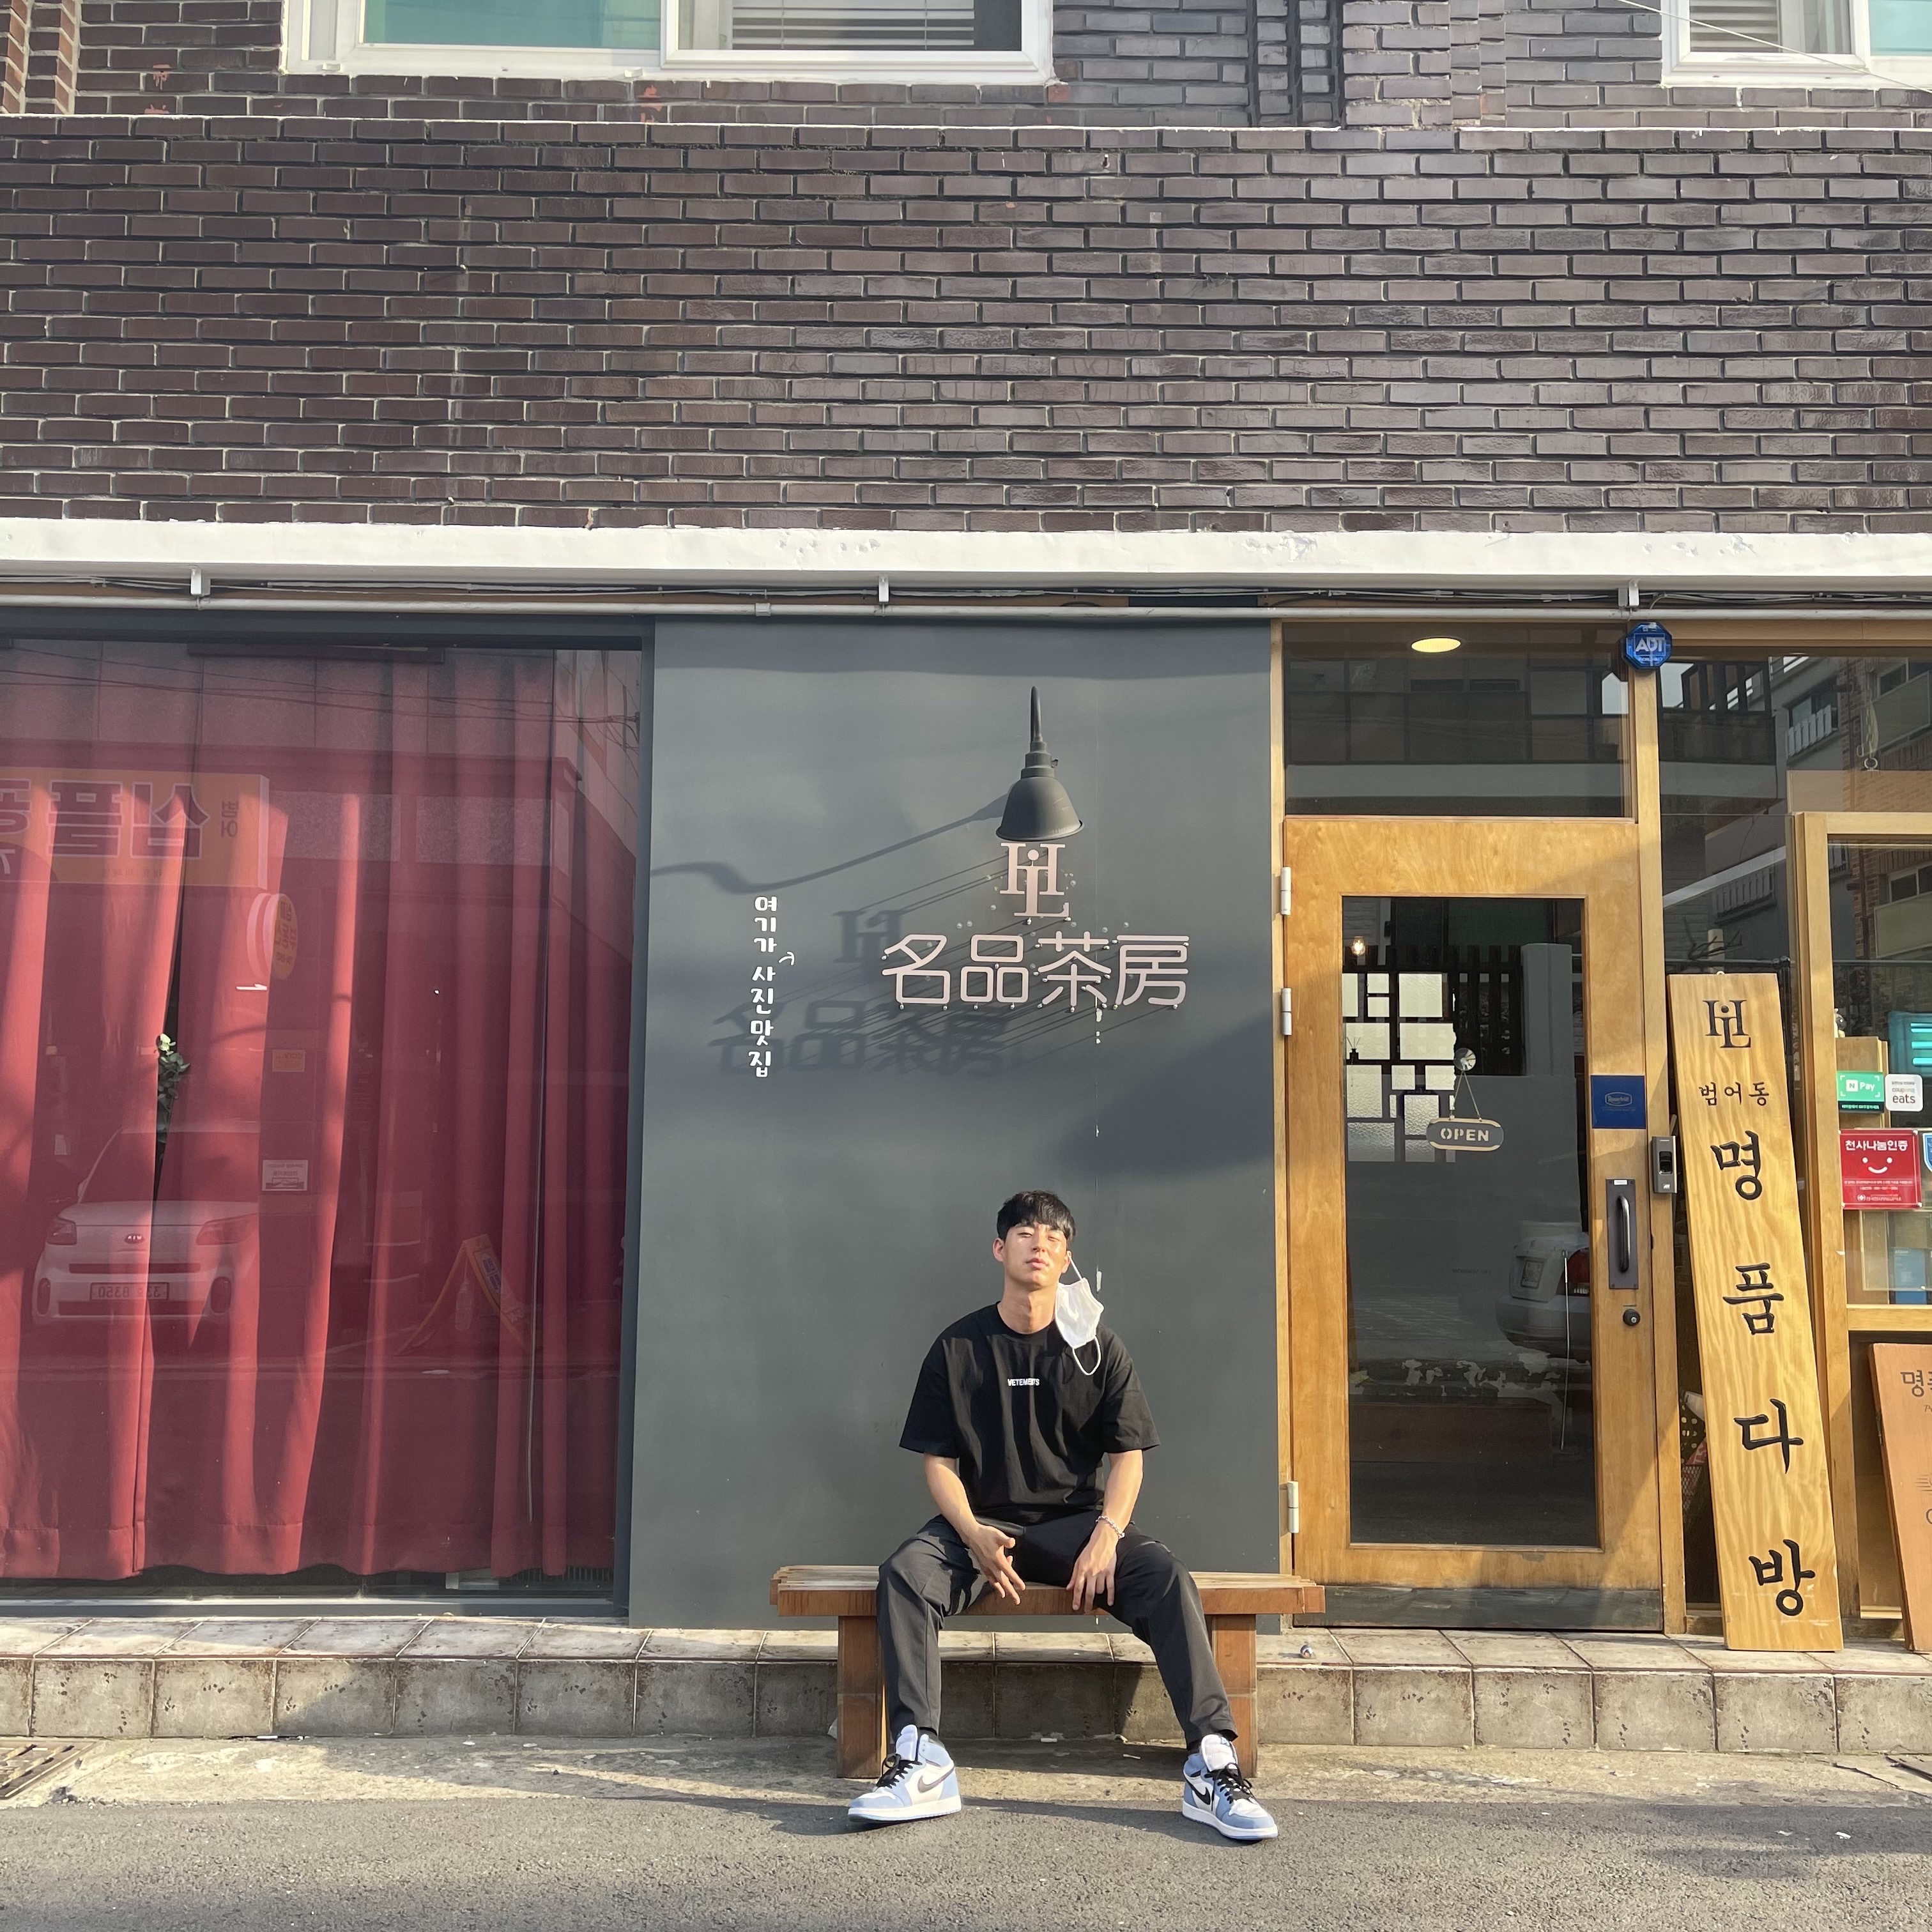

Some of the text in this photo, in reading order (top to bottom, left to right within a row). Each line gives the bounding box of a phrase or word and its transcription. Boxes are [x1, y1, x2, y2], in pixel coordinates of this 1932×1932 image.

[1635, 636, 1666, 652] ADT
[882, 931, 1190, 1007] 名品茶房
[748, 896, 778, 1078] 여기가 사진맛집
[1699, 1081, 1769, 1107] 범어동
[1859, 1081, 1876, 1092] Pay
[1892, 1094, 1915, 1103] eats
[1440, 1128, 1489, 1142] OPEN
[1845, 1140, 1908, 1152] 천사나눔인증
[1710, 1130, 1815, 1616] 명품다방
[1900, 1369, 1932, 1397] 명
